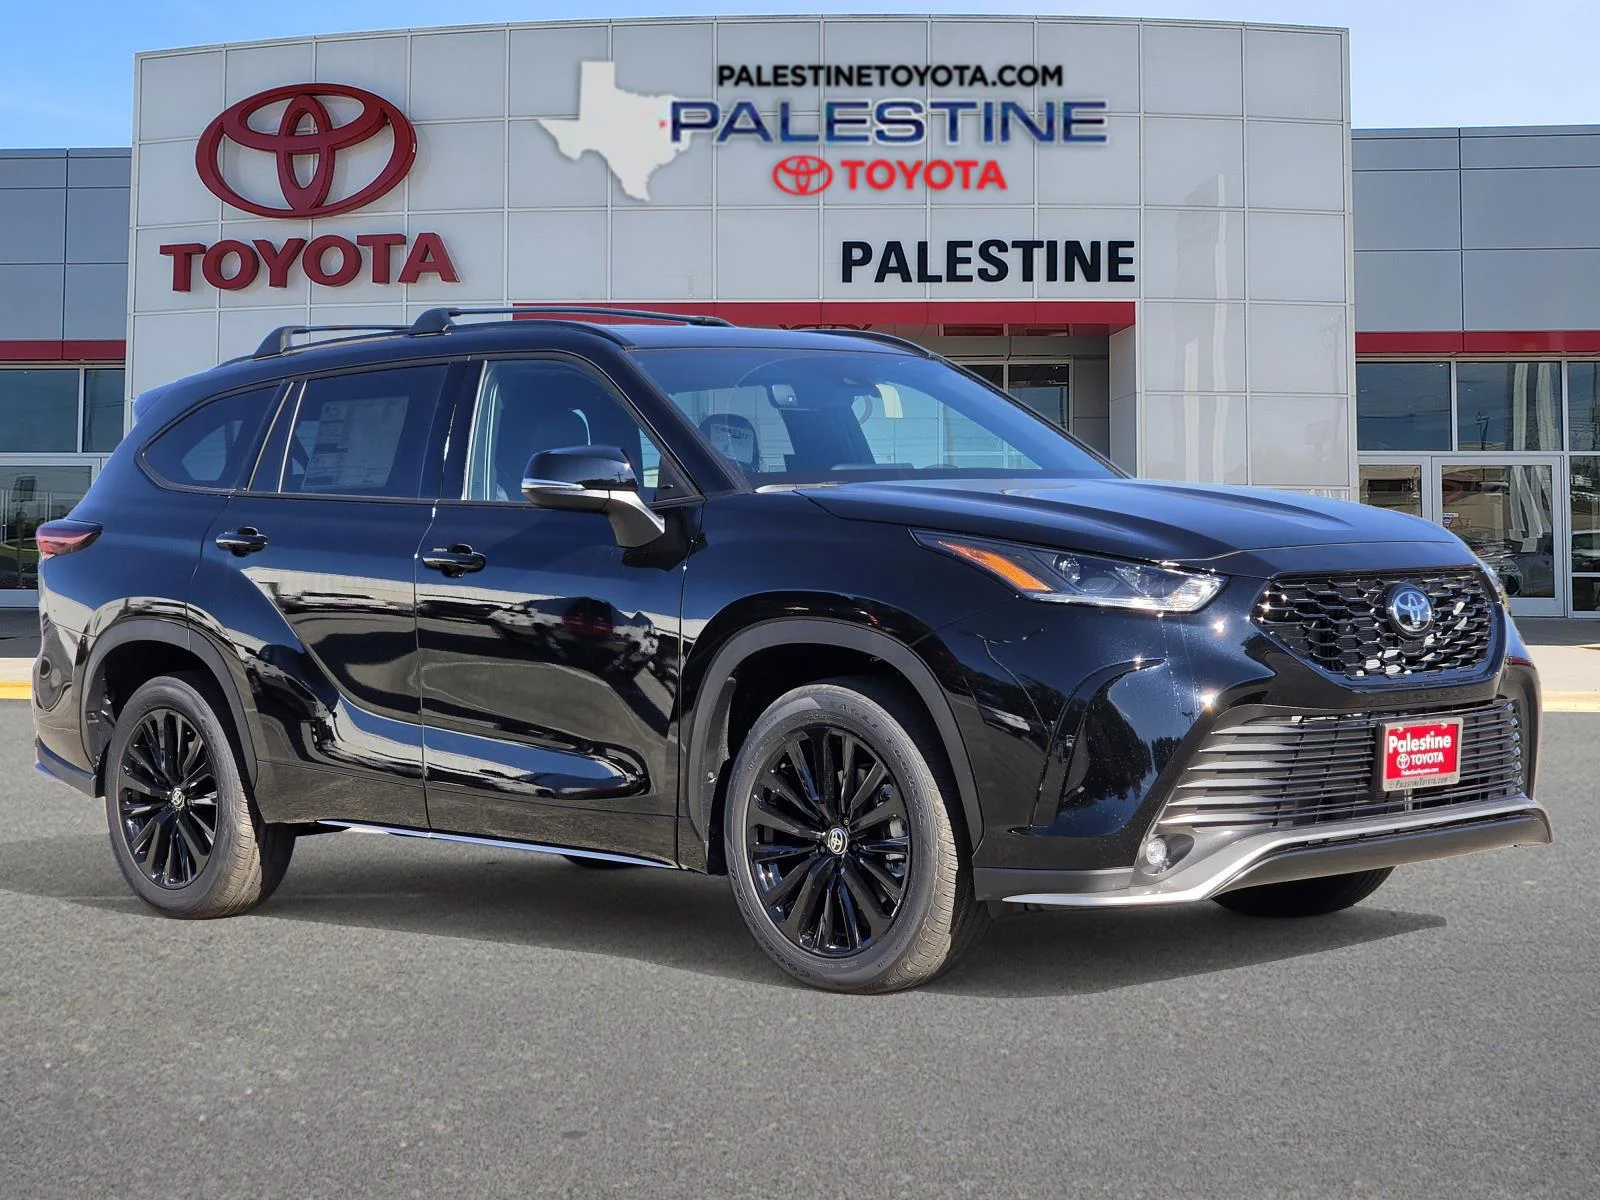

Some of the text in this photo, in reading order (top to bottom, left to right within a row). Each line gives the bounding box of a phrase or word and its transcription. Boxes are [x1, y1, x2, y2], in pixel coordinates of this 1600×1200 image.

[160, 232, 460, 292] TOYOTA
[842, 240, 1135, 283] PALESTINE
[1388, 731, 1452, 753] Palestine
[1410, 752, 1444, 765] TOYOTA
